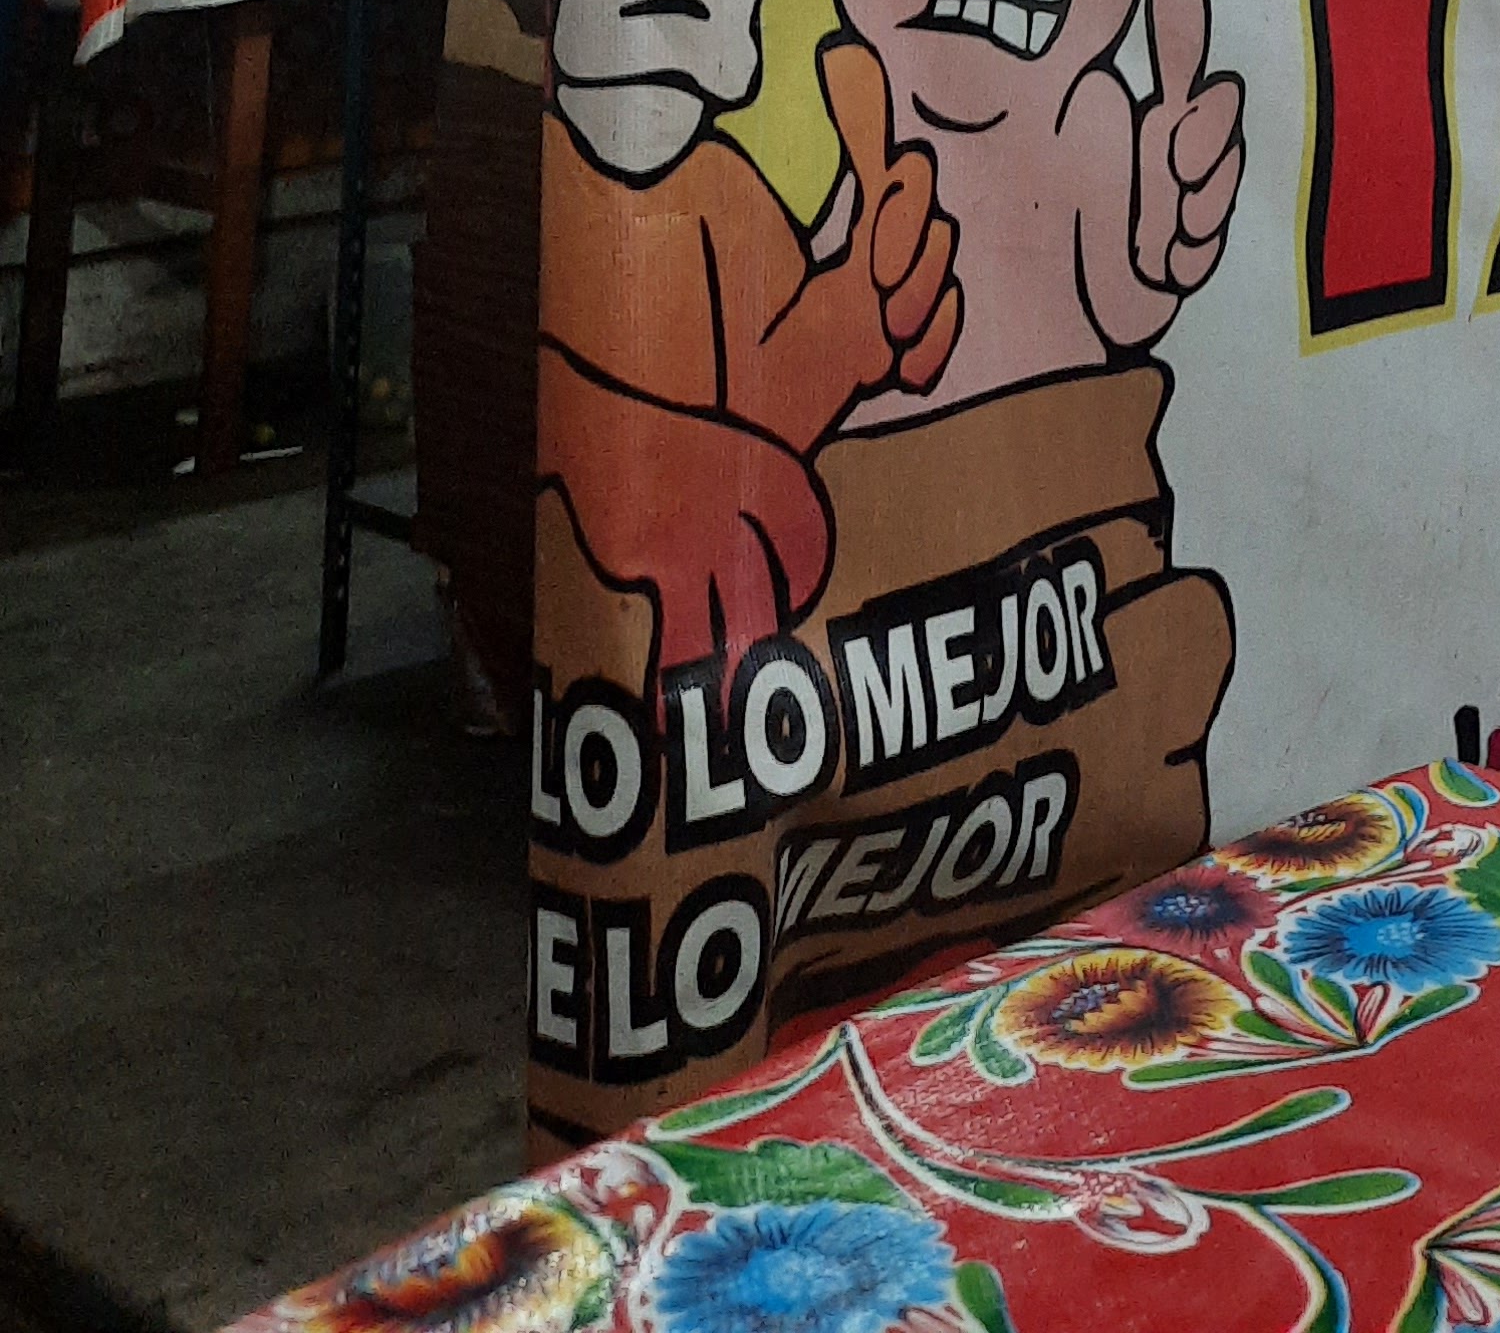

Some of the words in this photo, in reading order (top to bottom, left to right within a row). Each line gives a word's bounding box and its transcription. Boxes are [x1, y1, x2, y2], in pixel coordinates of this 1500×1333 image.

[679, 655, 827, 825] LO
[844, 557, 1106, 769] MEJOR
[533, 903, 580, 1047] E
[606, 897, 760, 1060] LO
